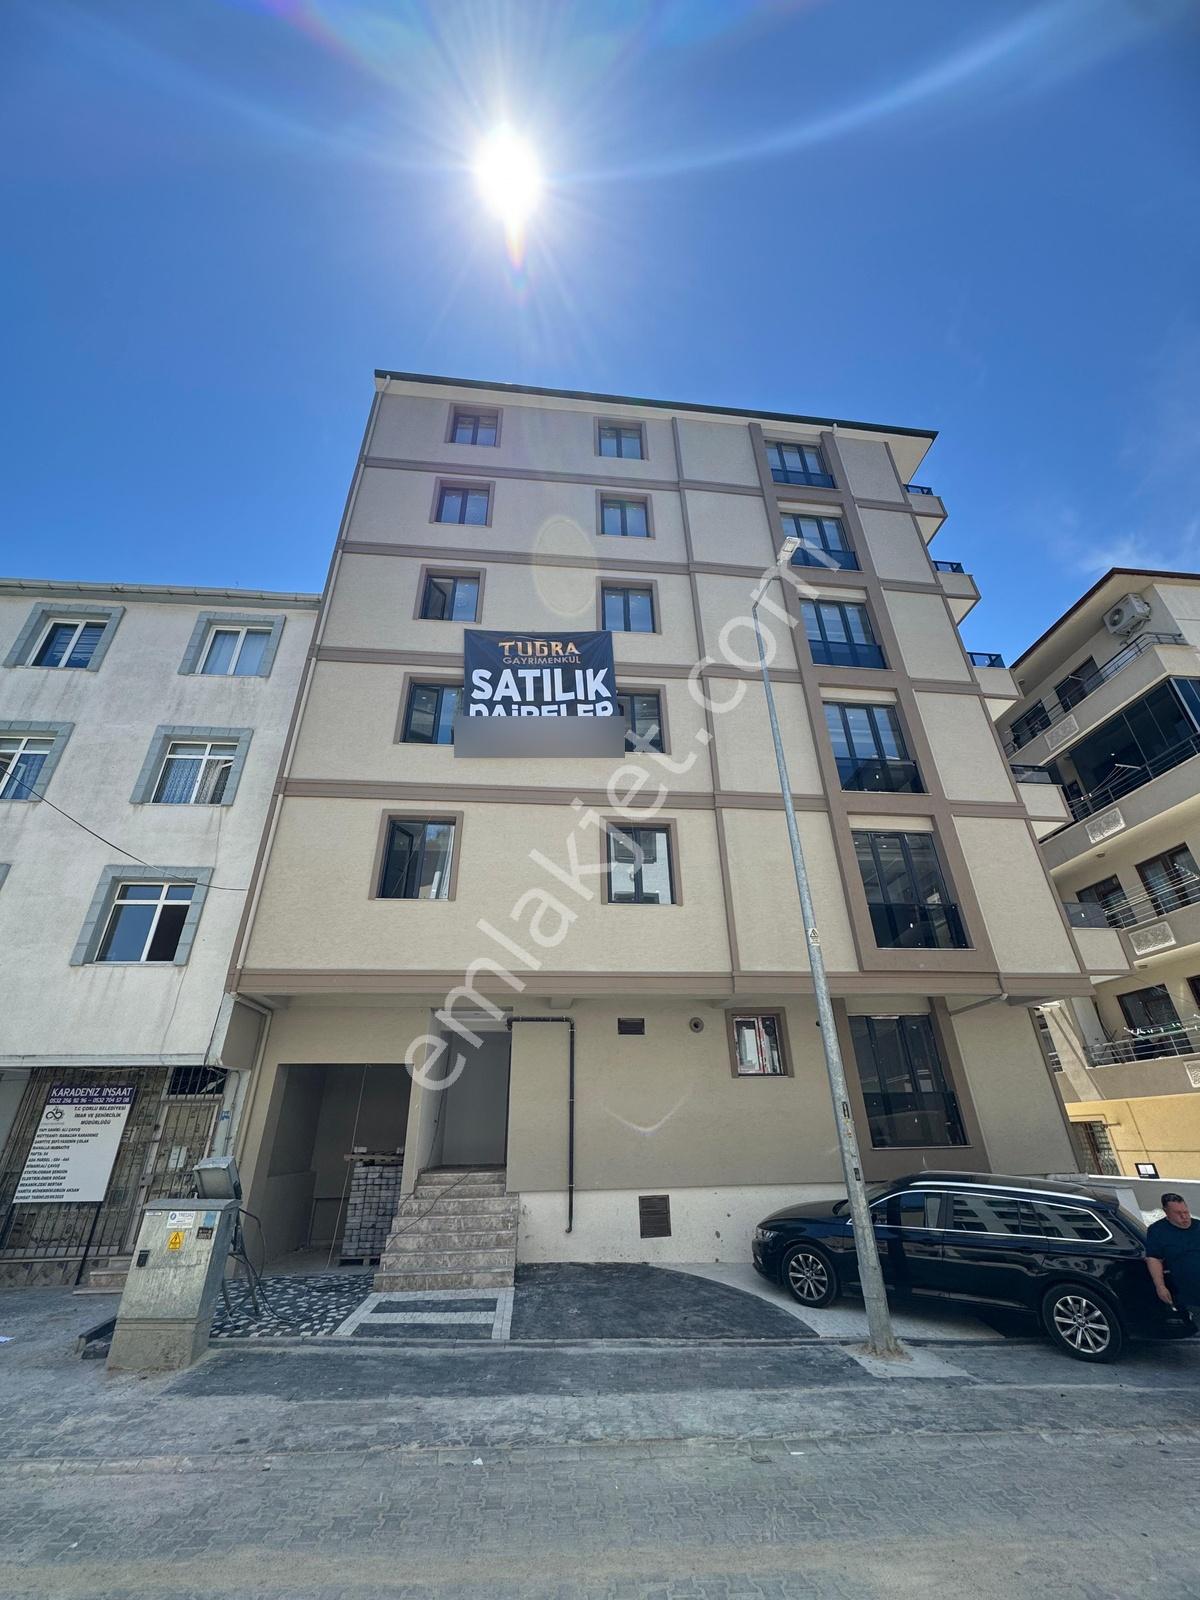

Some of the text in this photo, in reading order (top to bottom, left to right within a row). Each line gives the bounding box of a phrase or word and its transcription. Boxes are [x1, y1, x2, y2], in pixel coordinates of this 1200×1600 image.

[498, 640, 581, 656] TUĞRA
[502, 655, 581, 665] GAYRİMENKUL
[471, 667, 612, 702] SATILIK
[51, 1085, 101, 1097] KARADENİZ
